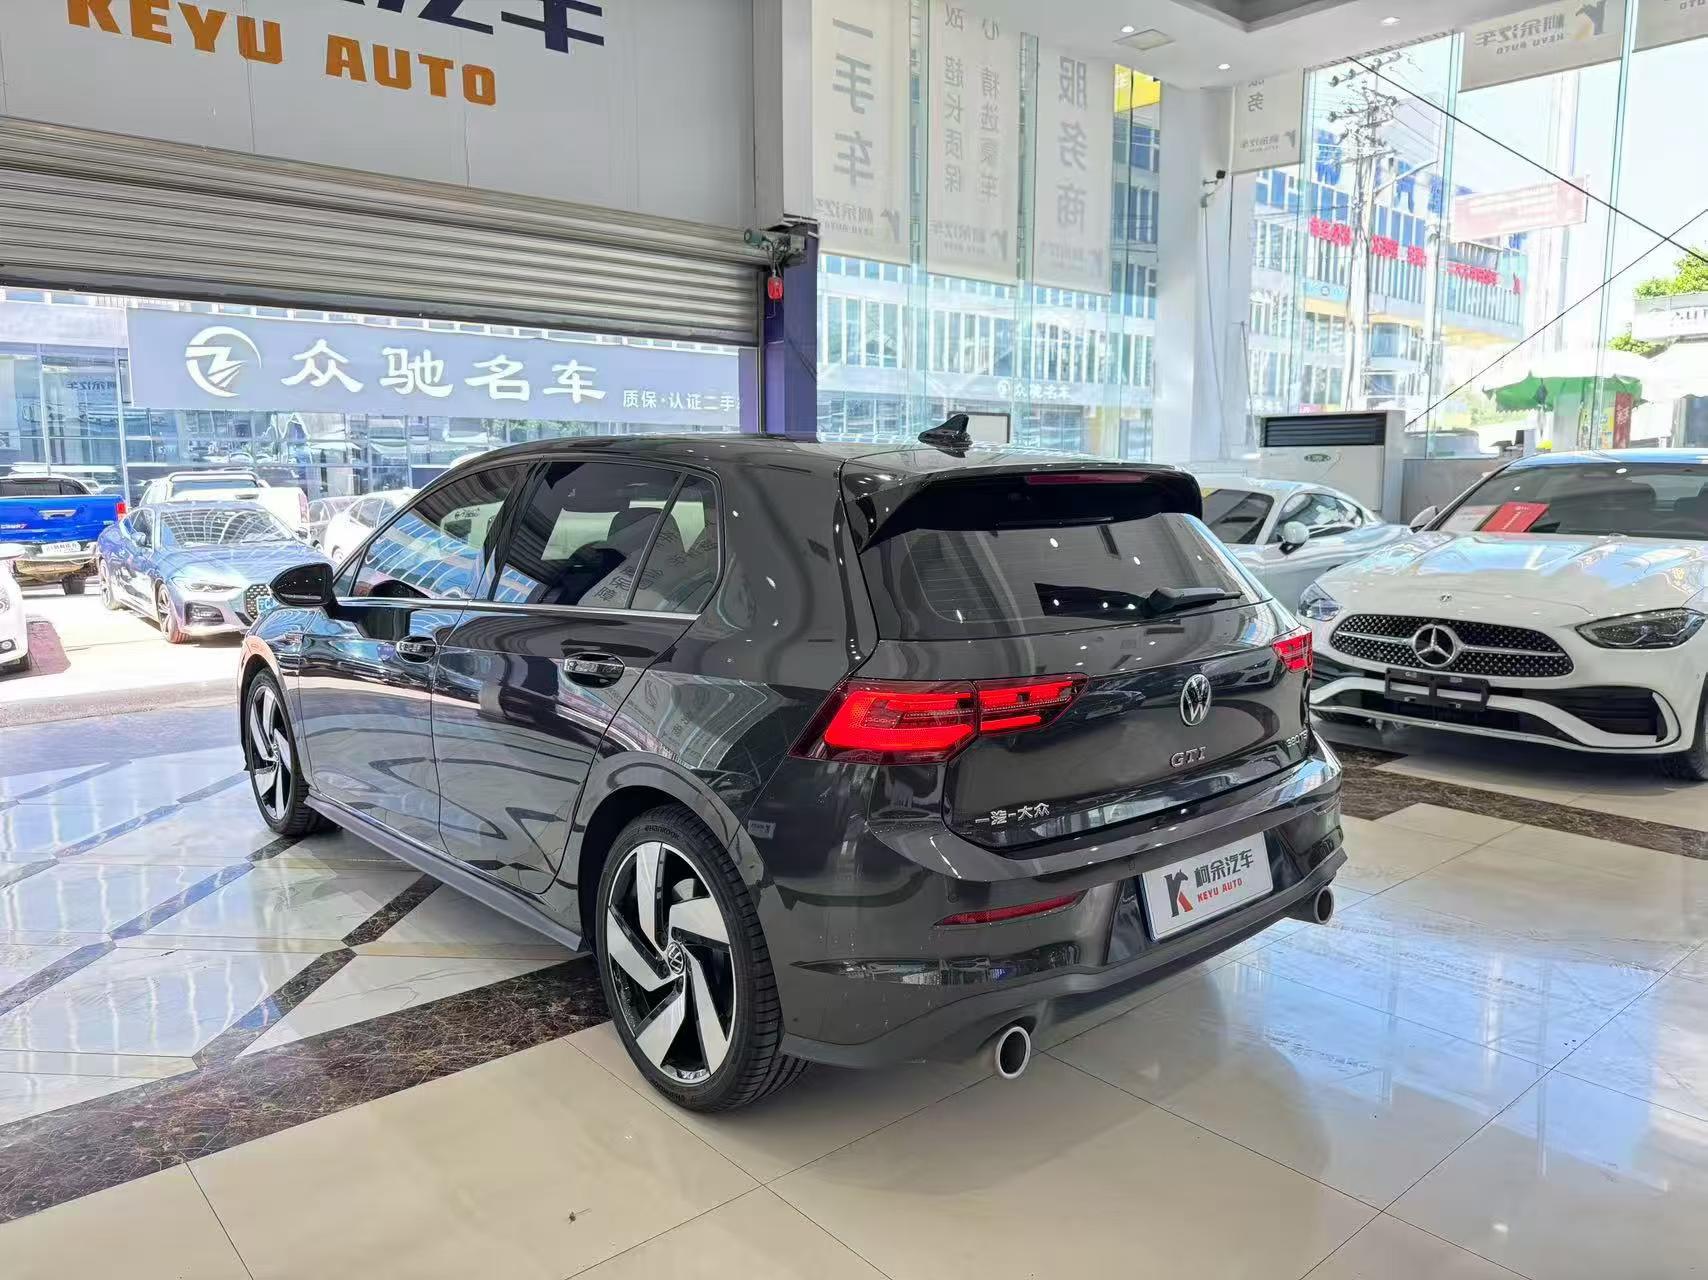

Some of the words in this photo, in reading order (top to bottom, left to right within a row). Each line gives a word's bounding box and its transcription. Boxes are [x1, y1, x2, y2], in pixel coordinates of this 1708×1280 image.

[66, 0, 284, 65] KEYU
[326, 34, 496, 106] AUTO
[281, 337, 607, 404] 众驰名车
[622, 388, 741, 413] 质保·认证二手
[1169, 745, 1208, 769] GTI
[1194, 847, 1254, 889] 柯余汽车
[1196, 886, 1219, 903] KEYU
[1221, 877, 1244, 896] AUTO
